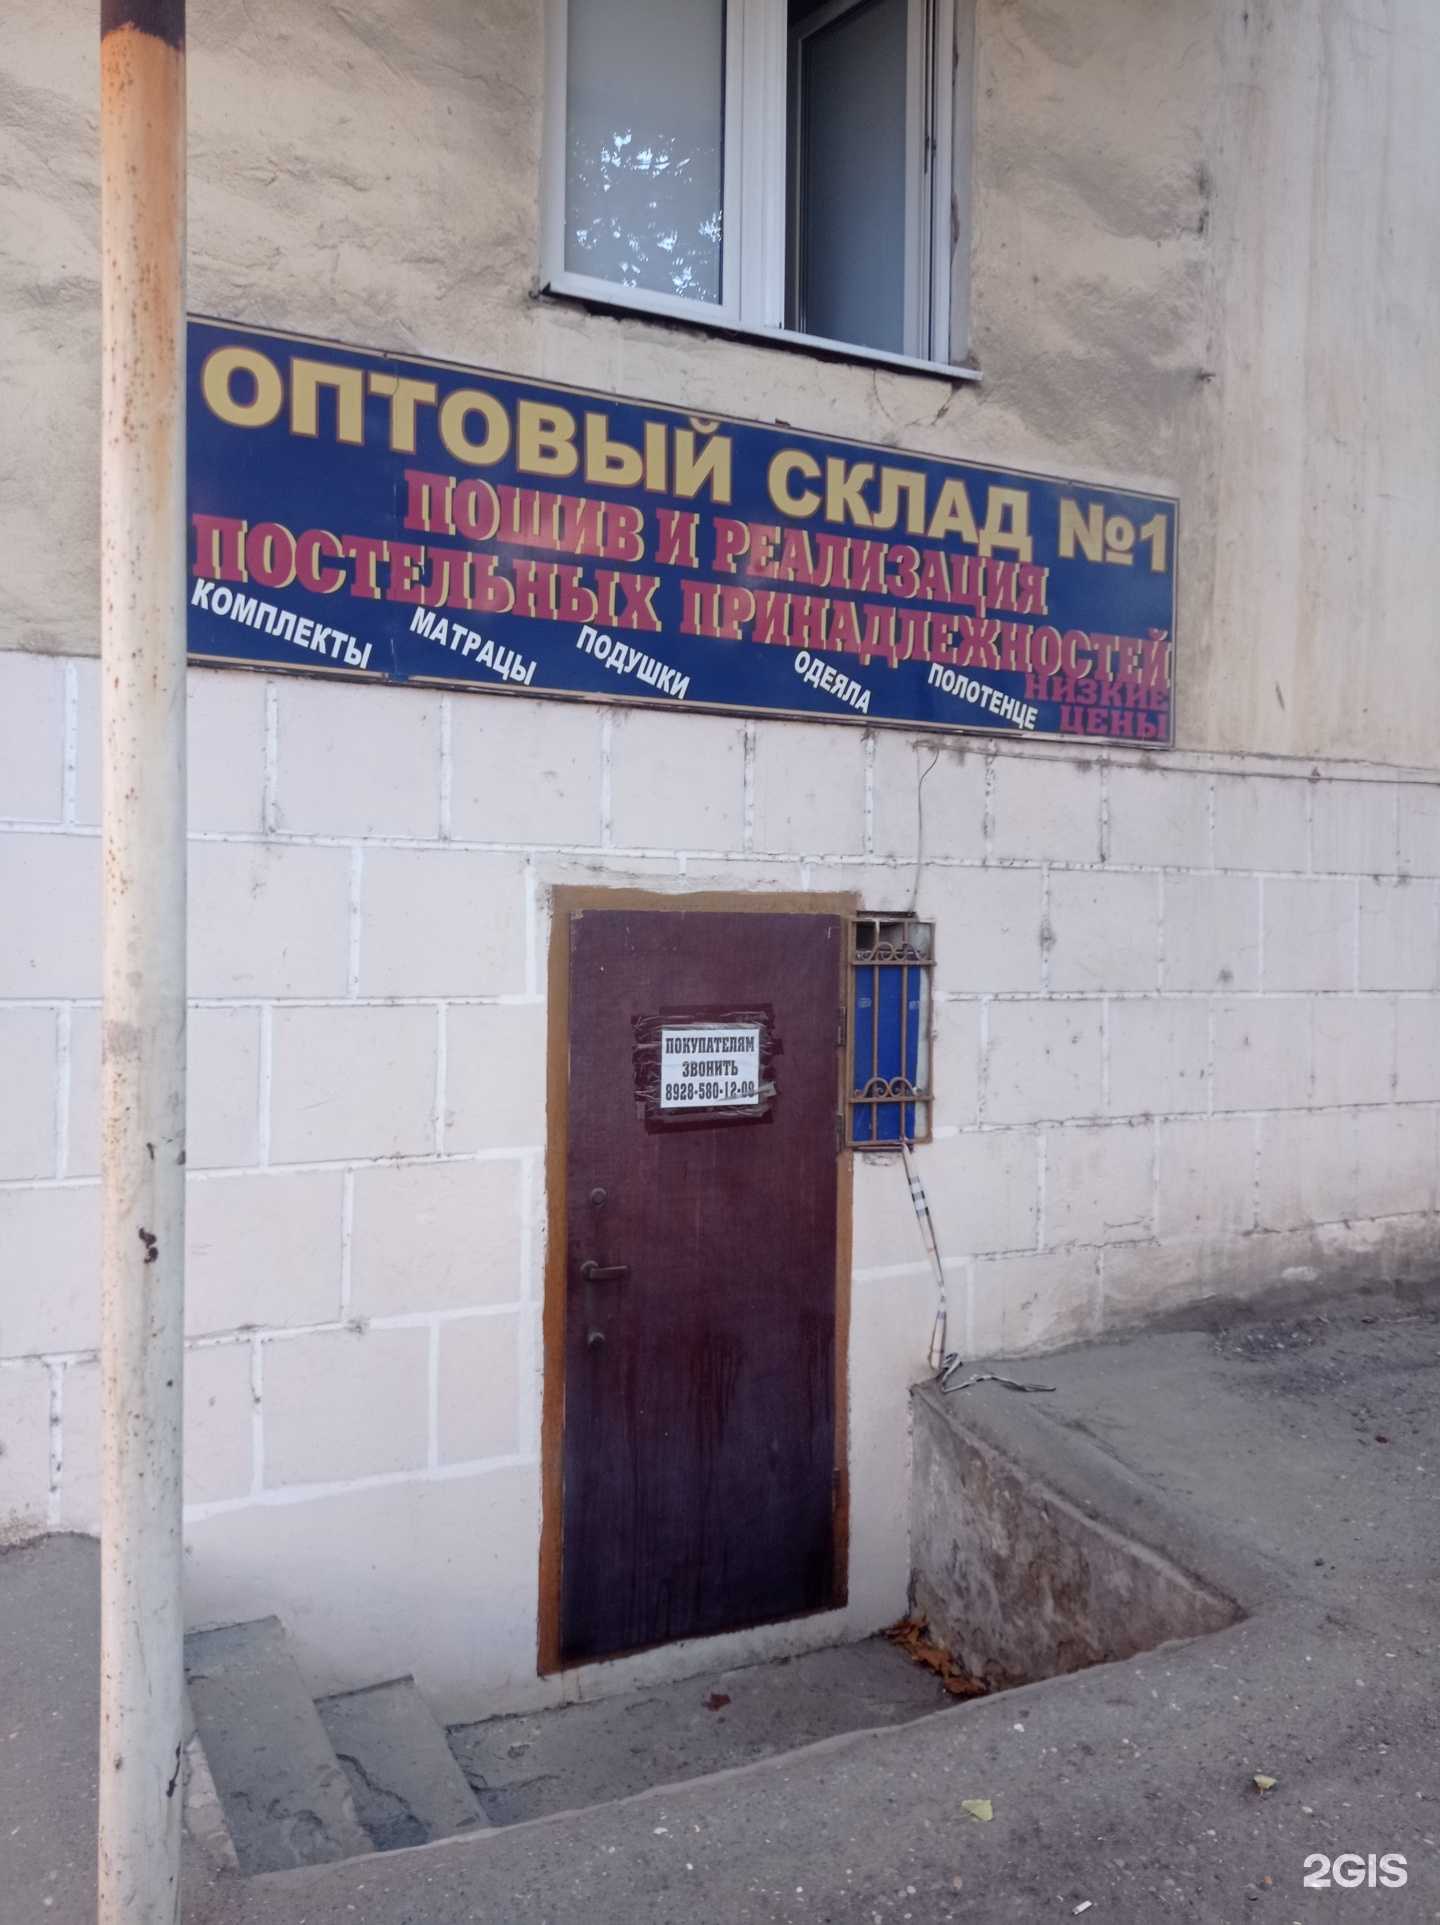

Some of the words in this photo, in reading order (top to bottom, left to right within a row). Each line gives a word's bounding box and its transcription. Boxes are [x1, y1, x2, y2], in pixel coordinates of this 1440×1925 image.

[202, 346, 732, 504] ОПТОВЫЙ
[766, 448, 1034, 563] СКЛАД
[1057, 498, 1169, 573] №1
[403, 469, 645, 562] ПОШИВ
[655, 508, 700, 569] И
[712, 516, 1050, 618] РЕАЛИЗАЦИЯ
[190, 577, 374, 670] КОМПЛЕКТЫ
[192, 513, 664, 633] ПОСТЕЛЬНЫХ
[680, 579, 1174, 688] ПРИНАДЛЕЖНОСТЕЙ
[409, 606, 538, 686] МАТРАЦЫ
[576, 624, 691, 700] ПОДУШКИ
[793, 650, 871, 714] ОДЕЯЛА
[927, 662, 1039, 731] ПОЛОТЕНЦЕ
[1023, 671, 1171, 713] НИЗКИЕ
[1058, 705, 1168, 742] ЦЕНЫ
[665, 1036, 755, 1054] ПОКУПАТЕЛЯМ
[682, 1060, 738, 1078] ЗВОНИТЬ
